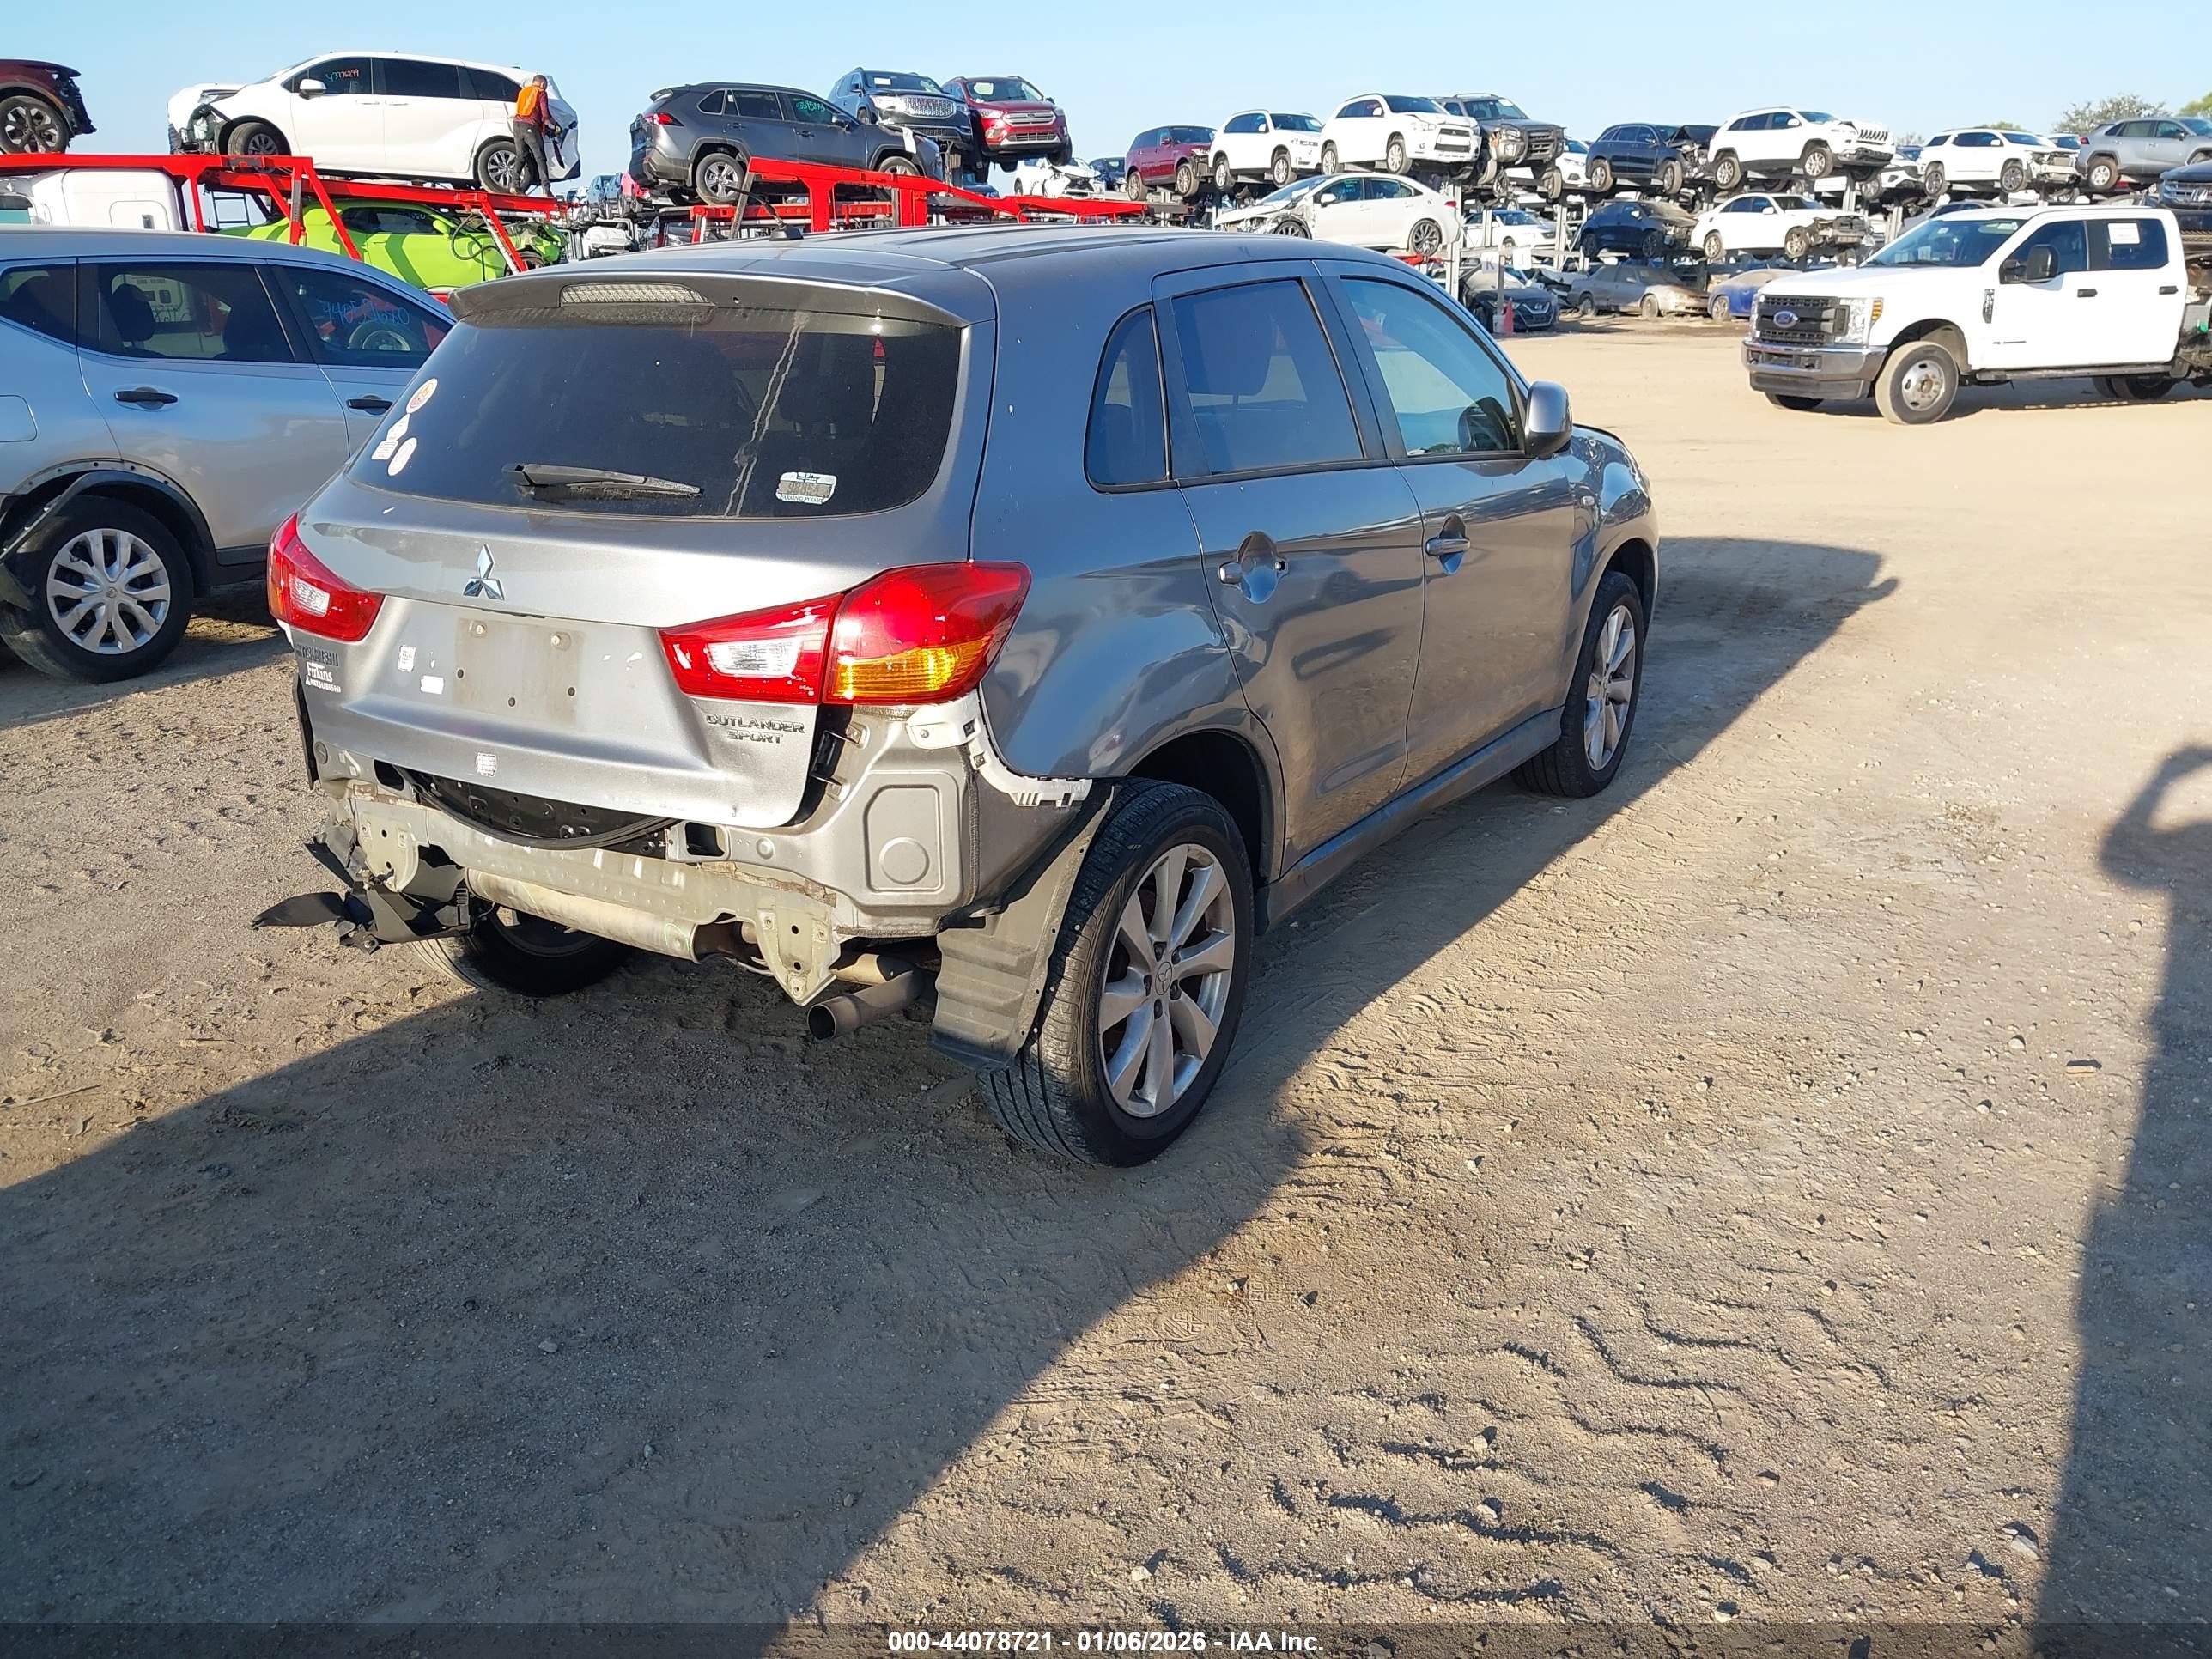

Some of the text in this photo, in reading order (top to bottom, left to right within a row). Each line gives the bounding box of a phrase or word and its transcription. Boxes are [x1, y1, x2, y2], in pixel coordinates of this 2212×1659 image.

[1486, 257, 1495, 270] K
[310, 678, 342, 693] MITSUBISHI
[706, 713, 805, 733] OUTLANDER
[727, 728, 783, 744] SPORT
